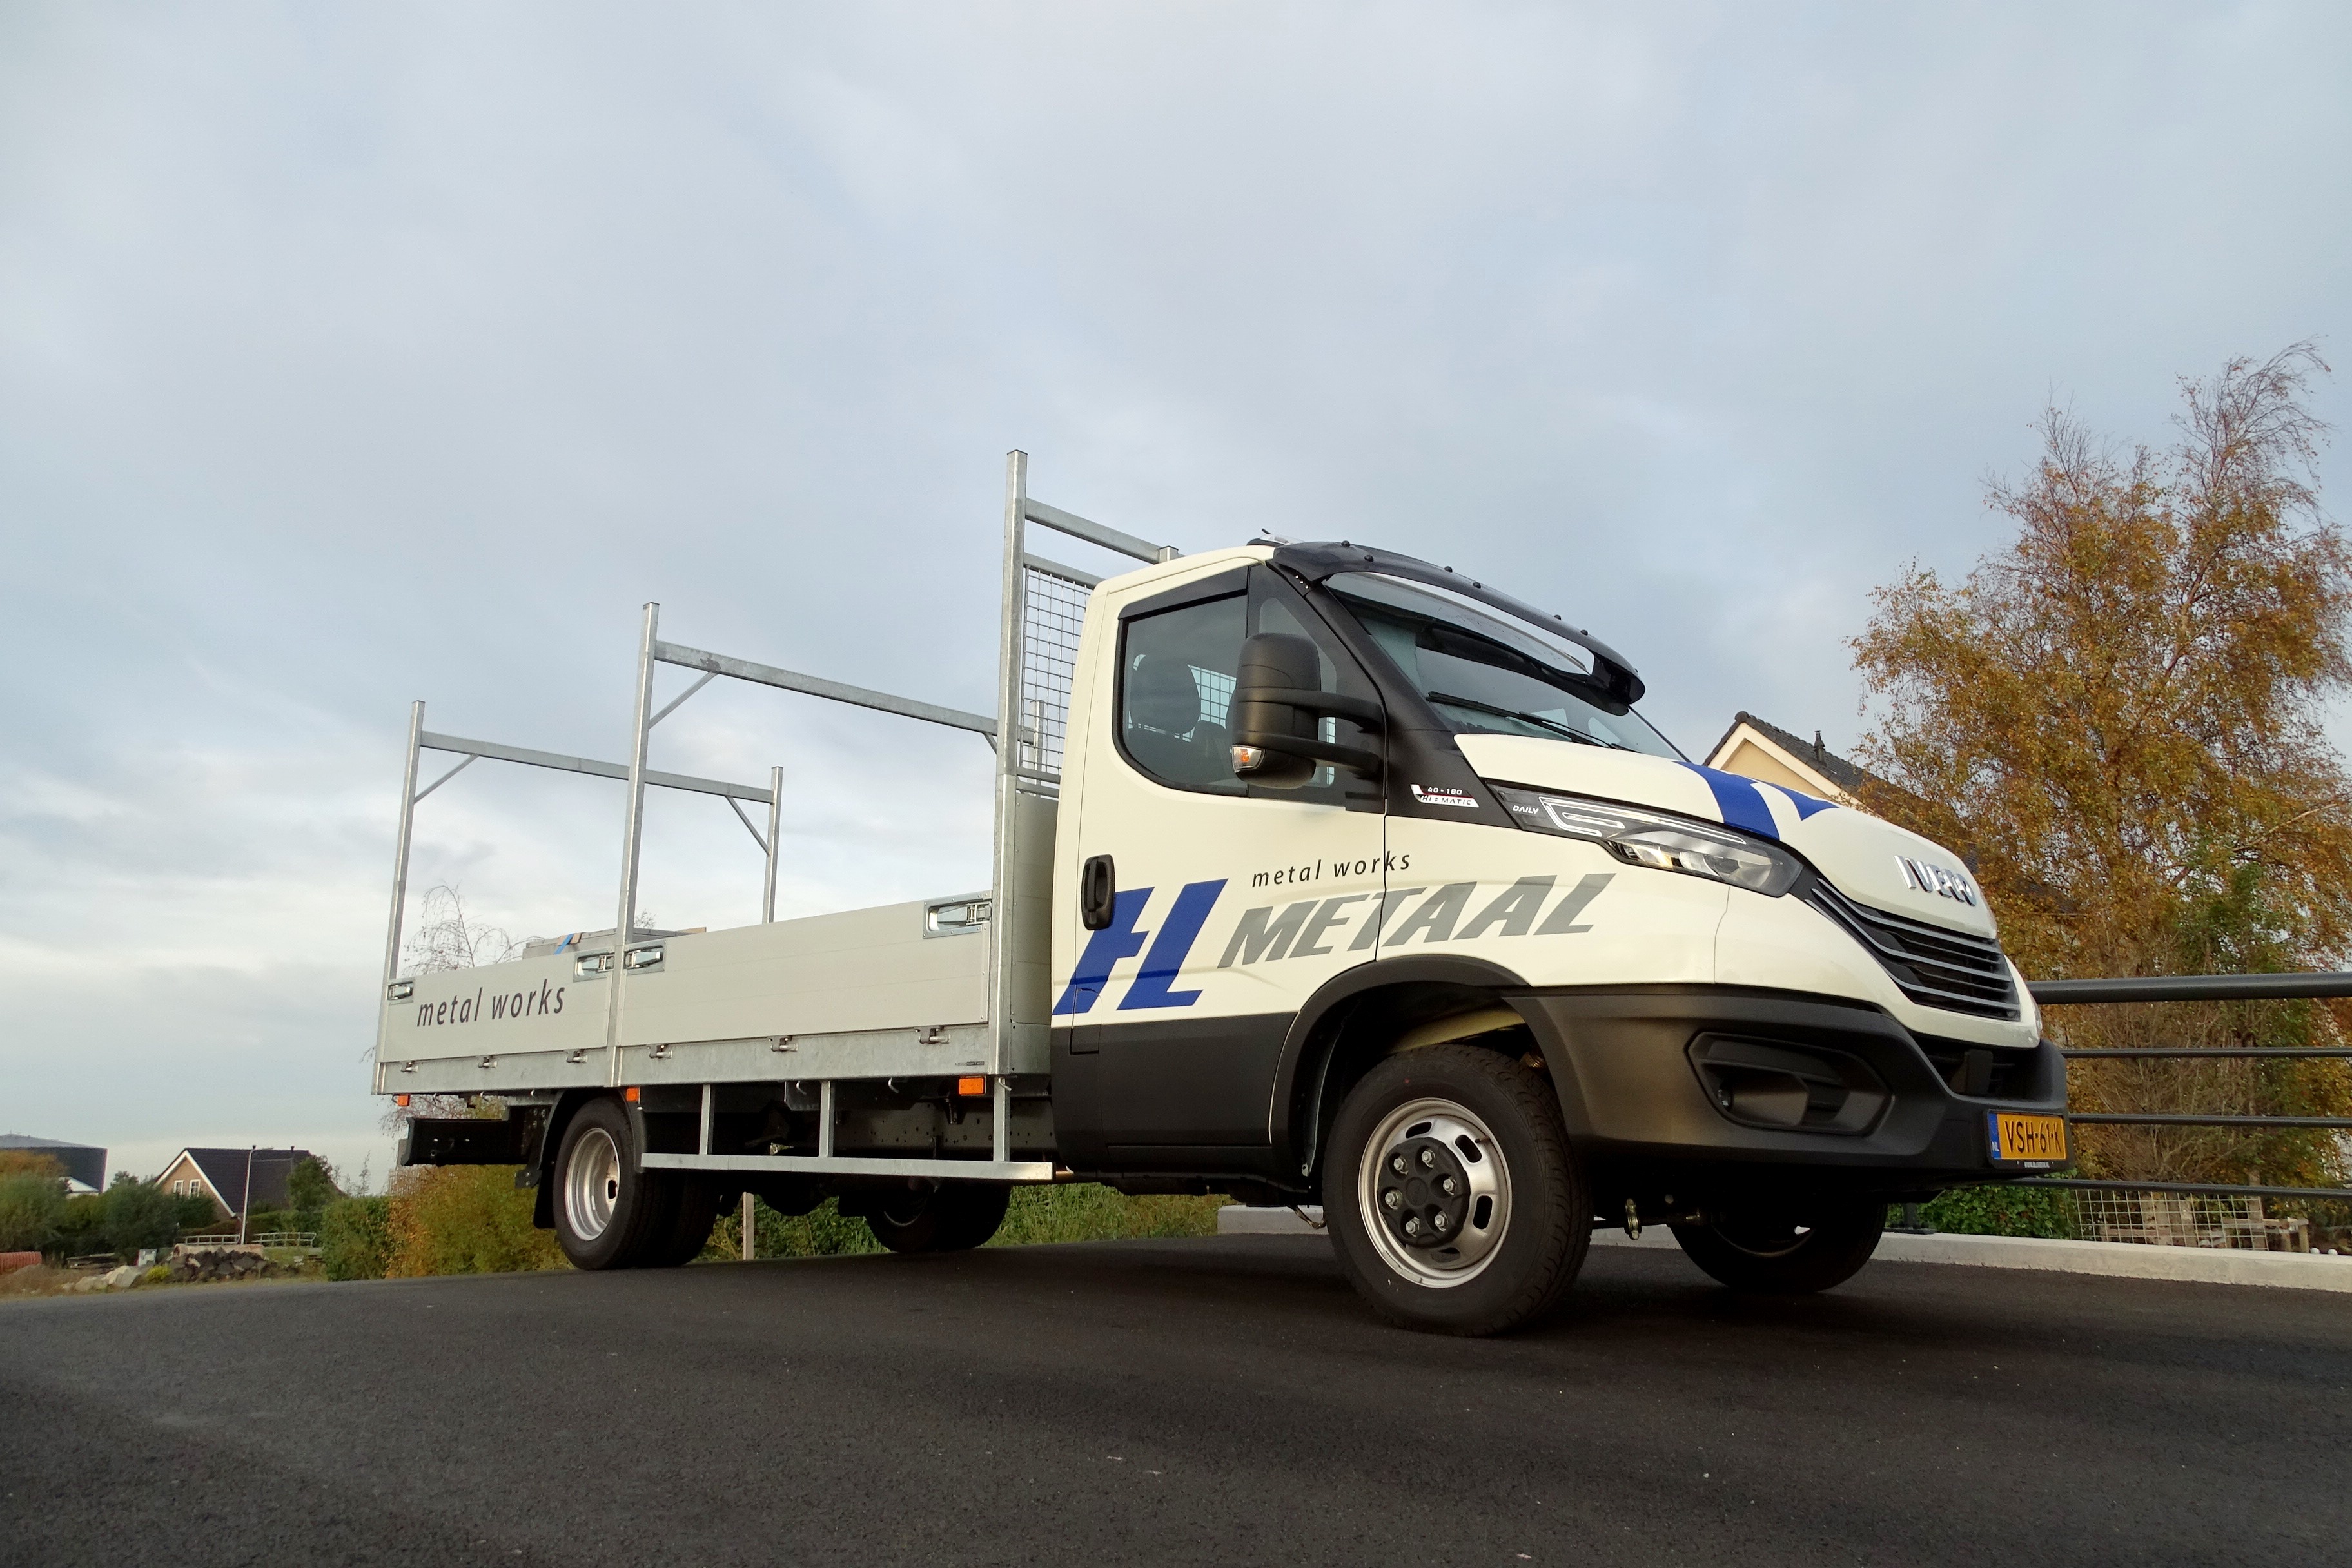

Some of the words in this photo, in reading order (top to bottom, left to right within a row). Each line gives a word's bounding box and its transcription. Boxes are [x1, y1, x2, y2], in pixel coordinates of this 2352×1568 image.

[1513, 805, 1539, 814] DAILY
[1252, 859, 1321, 887] metal
[1333, 851, 1410, 877] works
[1894, 855, 1976, 906] IVECO
[1217, 873, 1616, 969] METAAL
[416, 987, 483, 1028] metal
[491, 979, 565, 1020] works
[1992, 1141, 2000, 1152] NL
[2004, 1121, 2062, 1153] VSH-61-K
